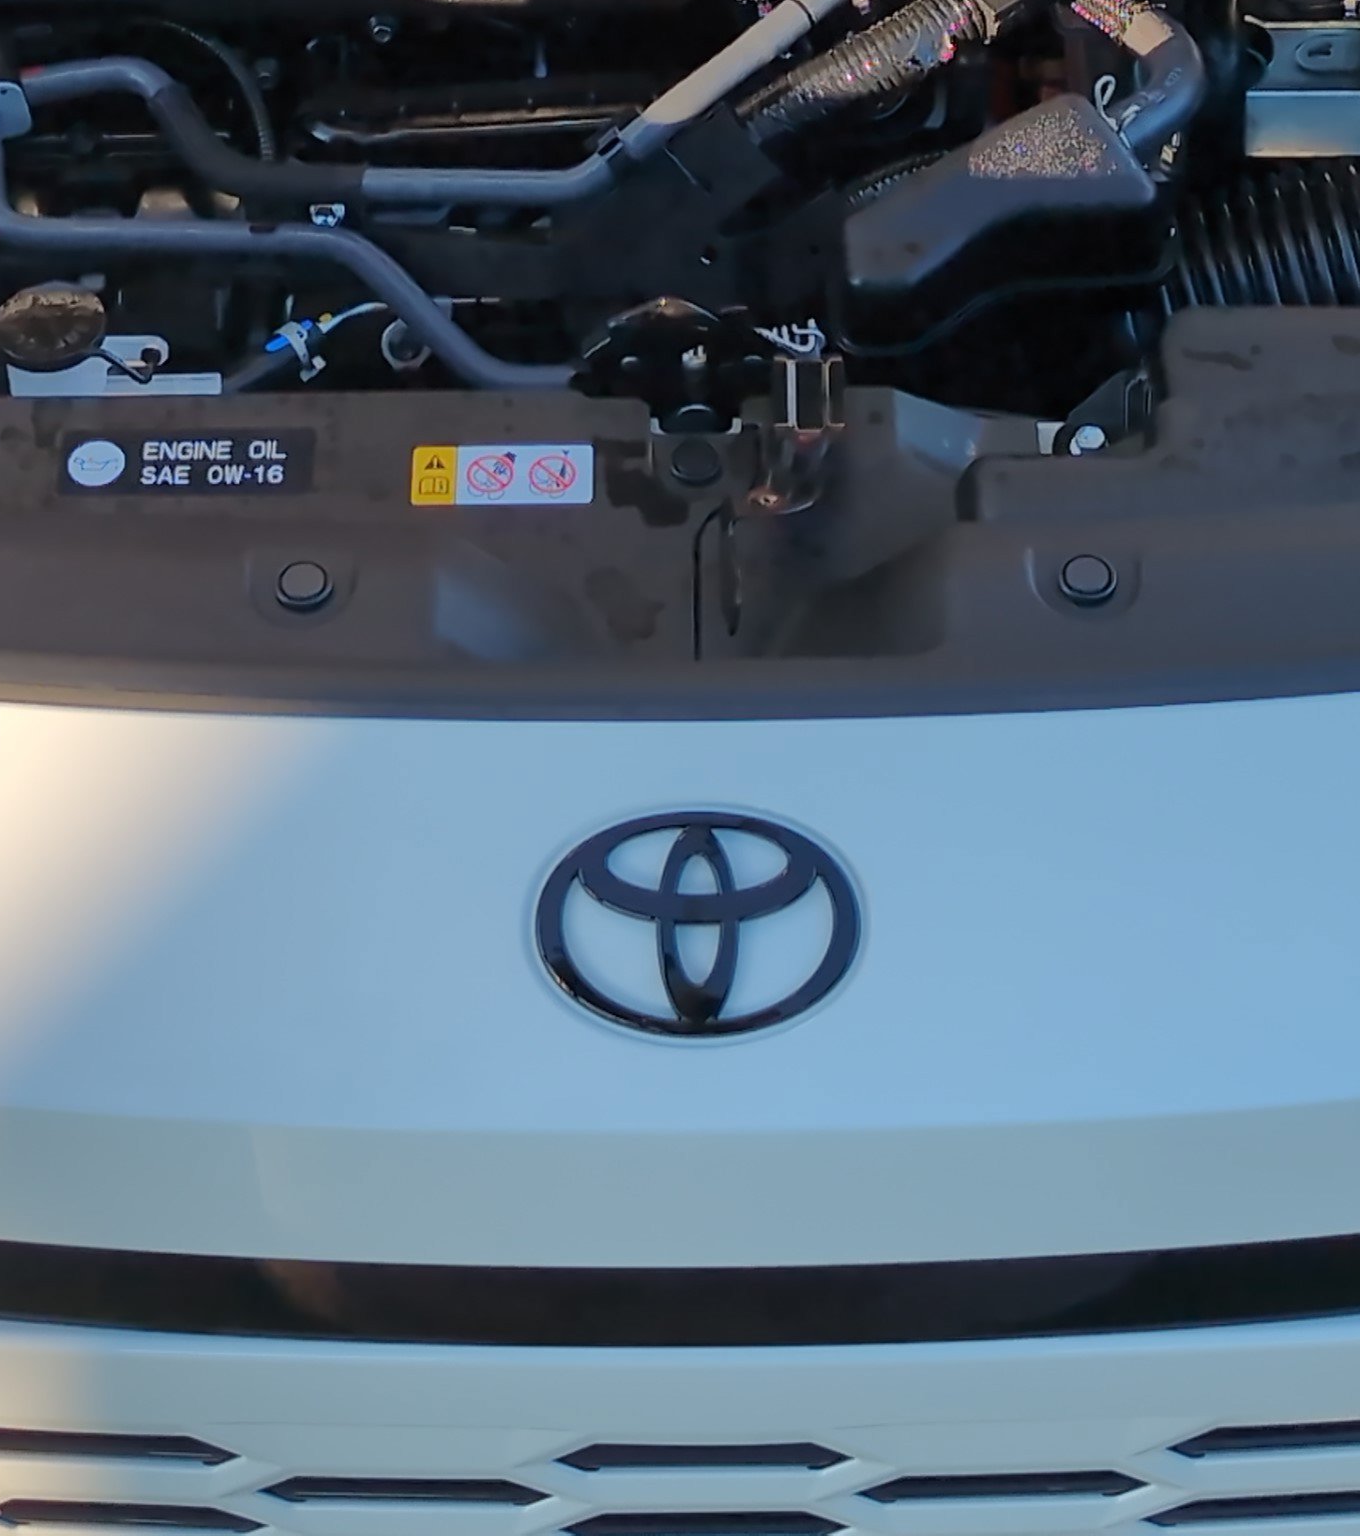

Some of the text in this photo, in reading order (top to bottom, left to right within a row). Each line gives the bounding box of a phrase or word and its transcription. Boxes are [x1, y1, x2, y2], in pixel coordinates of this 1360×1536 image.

[142, 439, 287, 461] ENGINE OIL
[140, 464, 284, 485] SAE 0W-16
